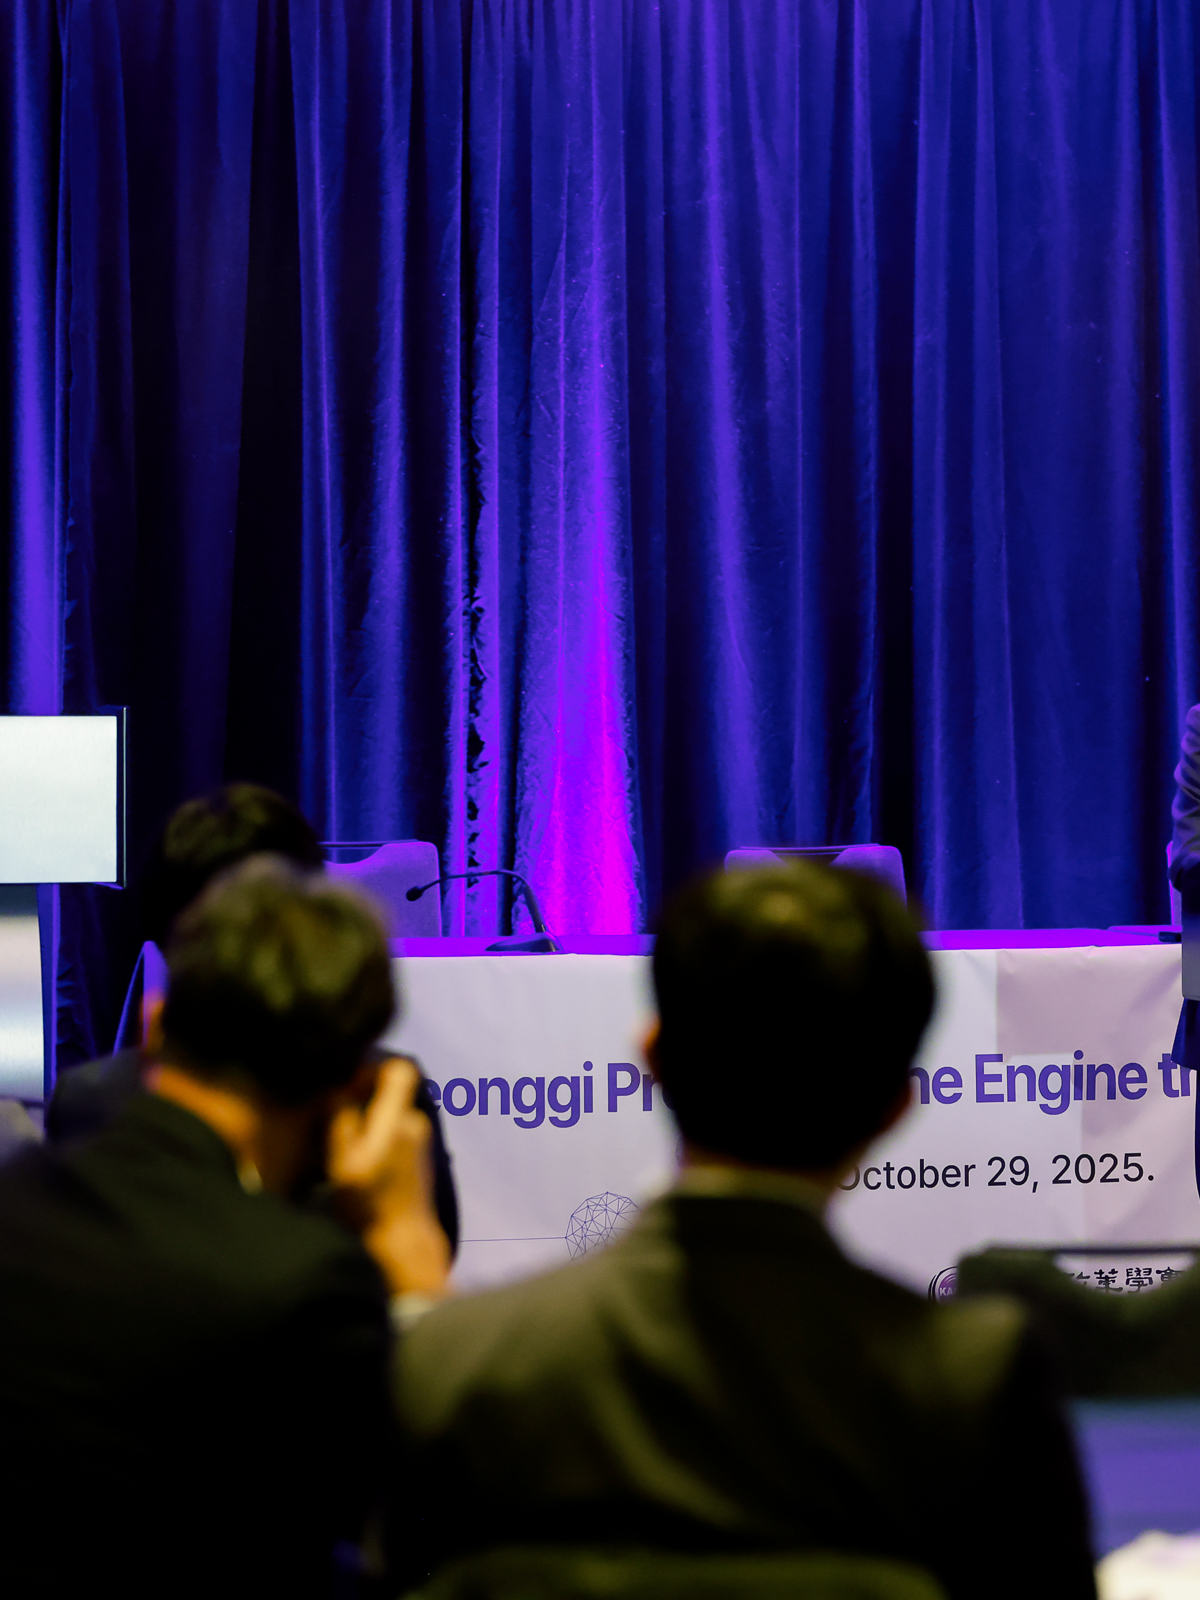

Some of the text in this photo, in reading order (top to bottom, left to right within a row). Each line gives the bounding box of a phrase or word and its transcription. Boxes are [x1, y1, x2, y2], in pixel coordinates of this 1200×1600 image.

[608, 1063, 672, 1112] Pr
[975, 1050, 1148, 1115] Engine
[838, 1153, 1155, 1193] October 29, 2025.
